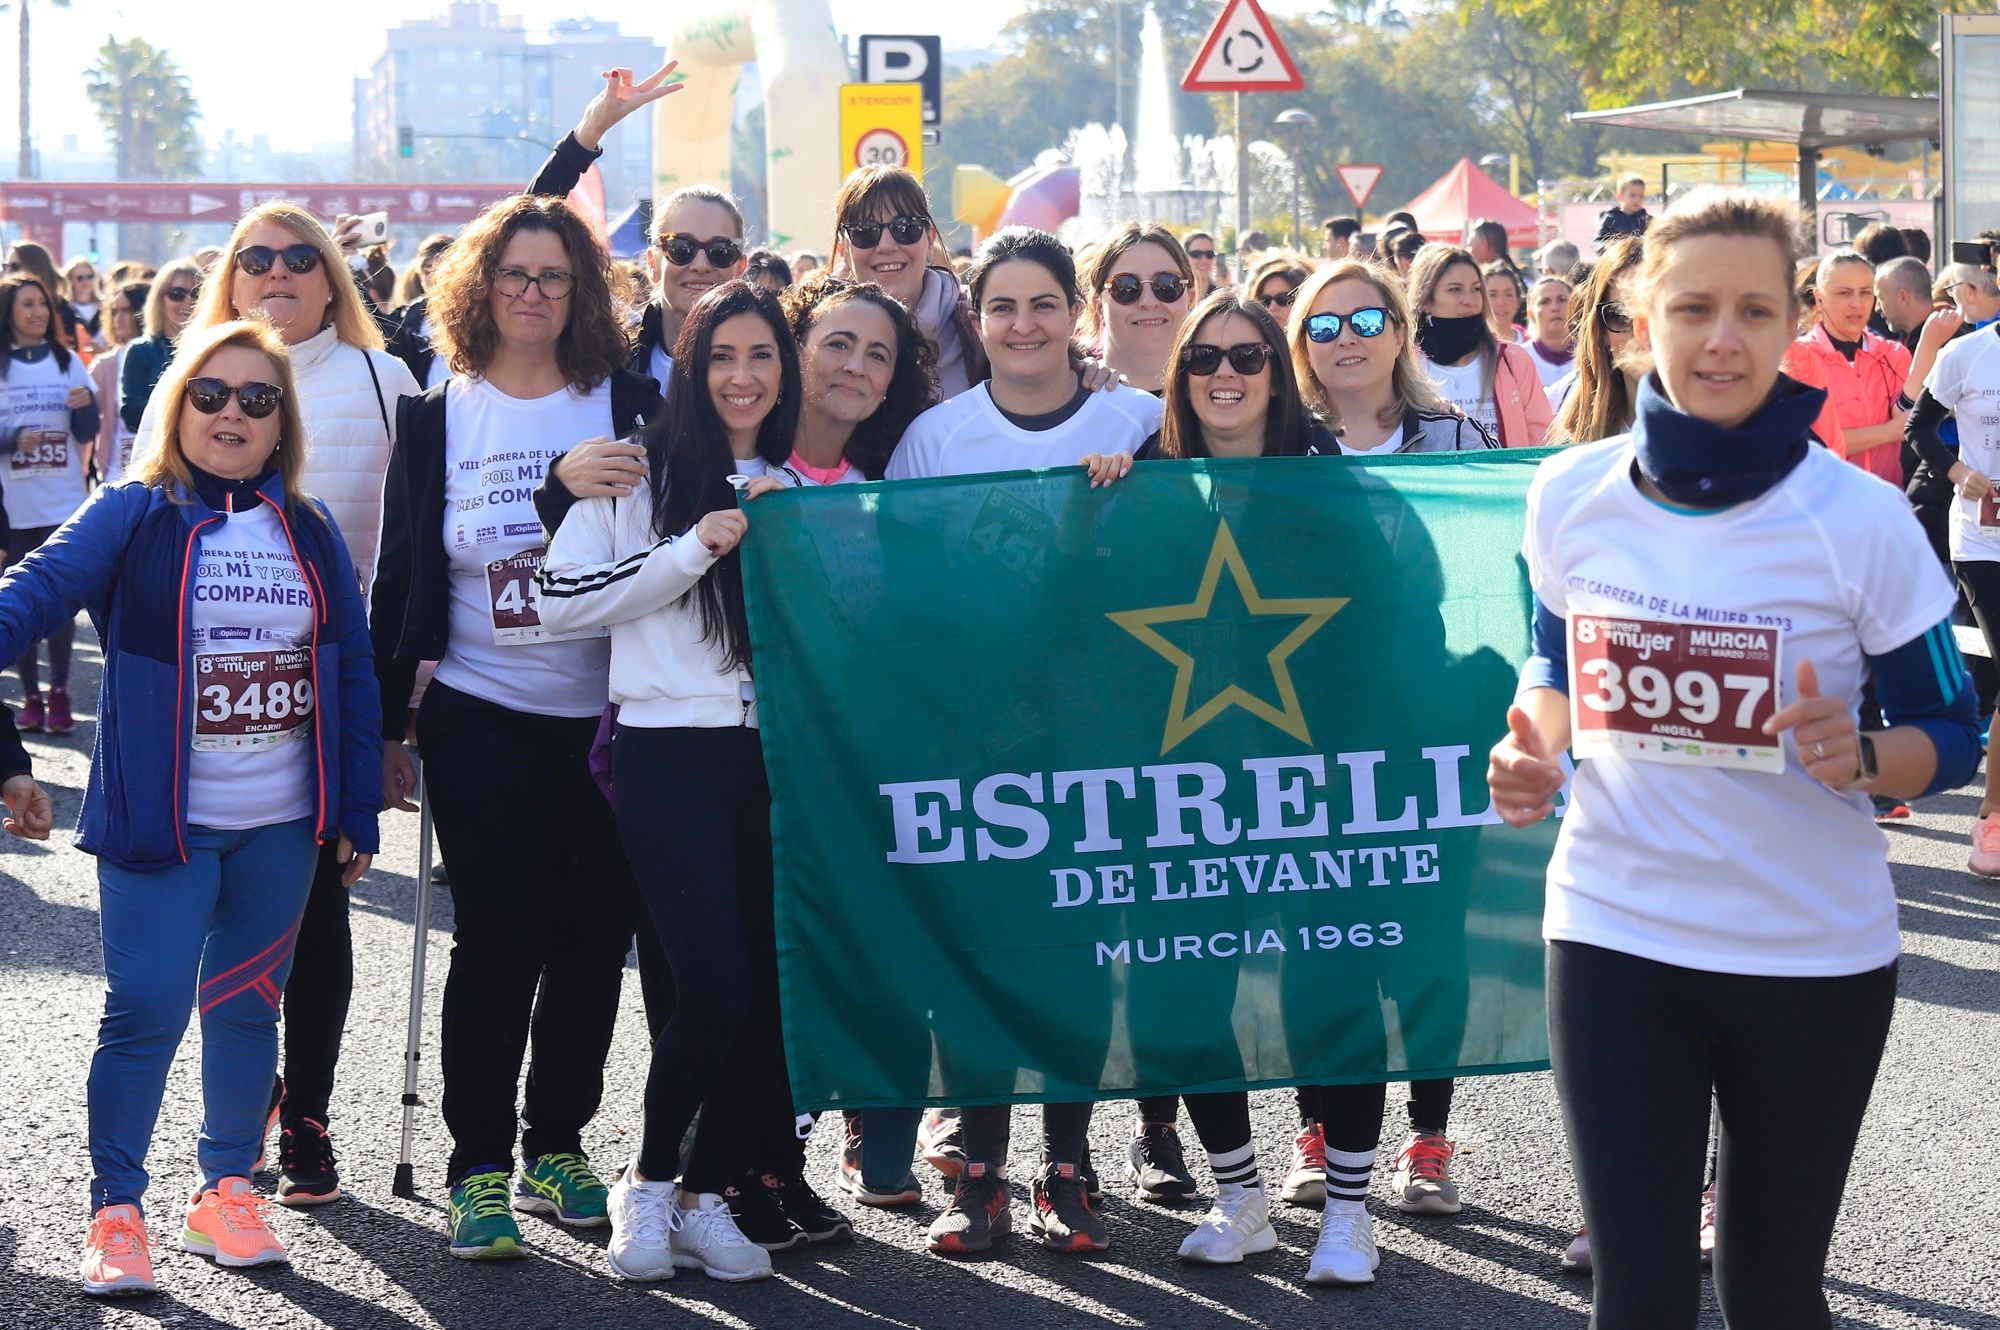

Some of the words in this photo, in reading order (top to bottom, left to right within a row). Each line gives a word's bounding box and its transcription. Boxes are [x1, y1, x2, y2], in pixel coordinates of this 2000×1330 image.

[867, 39, 928, 82] P
[850, 95, 913, 106] ATENCIÓN
[867, 147, 897, 164] 30
[459, 461, 479, 470] VIII
[482, 452, 526, 467] CARRERA
[529, 450, 542, 459] DE
[545, 449, 558, 459] LA
[482, 469, 515, 487] POR
[517, 460, 543, 481] MÍ
[456, 496, 484, 513] MIS
[235, 551, 247, 559] DE
[251, 551, 265, 560] LA
[226, 560, 252, 578] MÍ
[255, 565, 268, 580] Y
[271, 567, 307, 583] POR
[194, 583, 314, 608] COMPAÑER
[1587, 580, 1644, 607] CARRERA
[1649, 597, 1669, 613] DE
[1672, 602, 1690, 619] LA
[1695, 607, 1748, 624] MUJER
[1599, 621, 1642, 633] carrera
[1611, 630, 1675, 661] mujer
[1689, 630, 1769, 651] MURCIA
[215, 655, 244, 663] carrera
[1710, 648, 1745, 659] MARZO
[223, 660, 266, 679] mujer
[201, 678, 315, 723] 3489
[1580, 658, 1770, 730] 3997
[245, 724, 282, 733] ENCARNI
[1651, 724, 1705, 739] ANGELA
[1050, 864, 1137, 908] DE
[1150, 843, 1440, 902] LEVANTE
[1096, 929, 1287, 966] MURCIA
[1299, 922, 1404, 950] 1963
